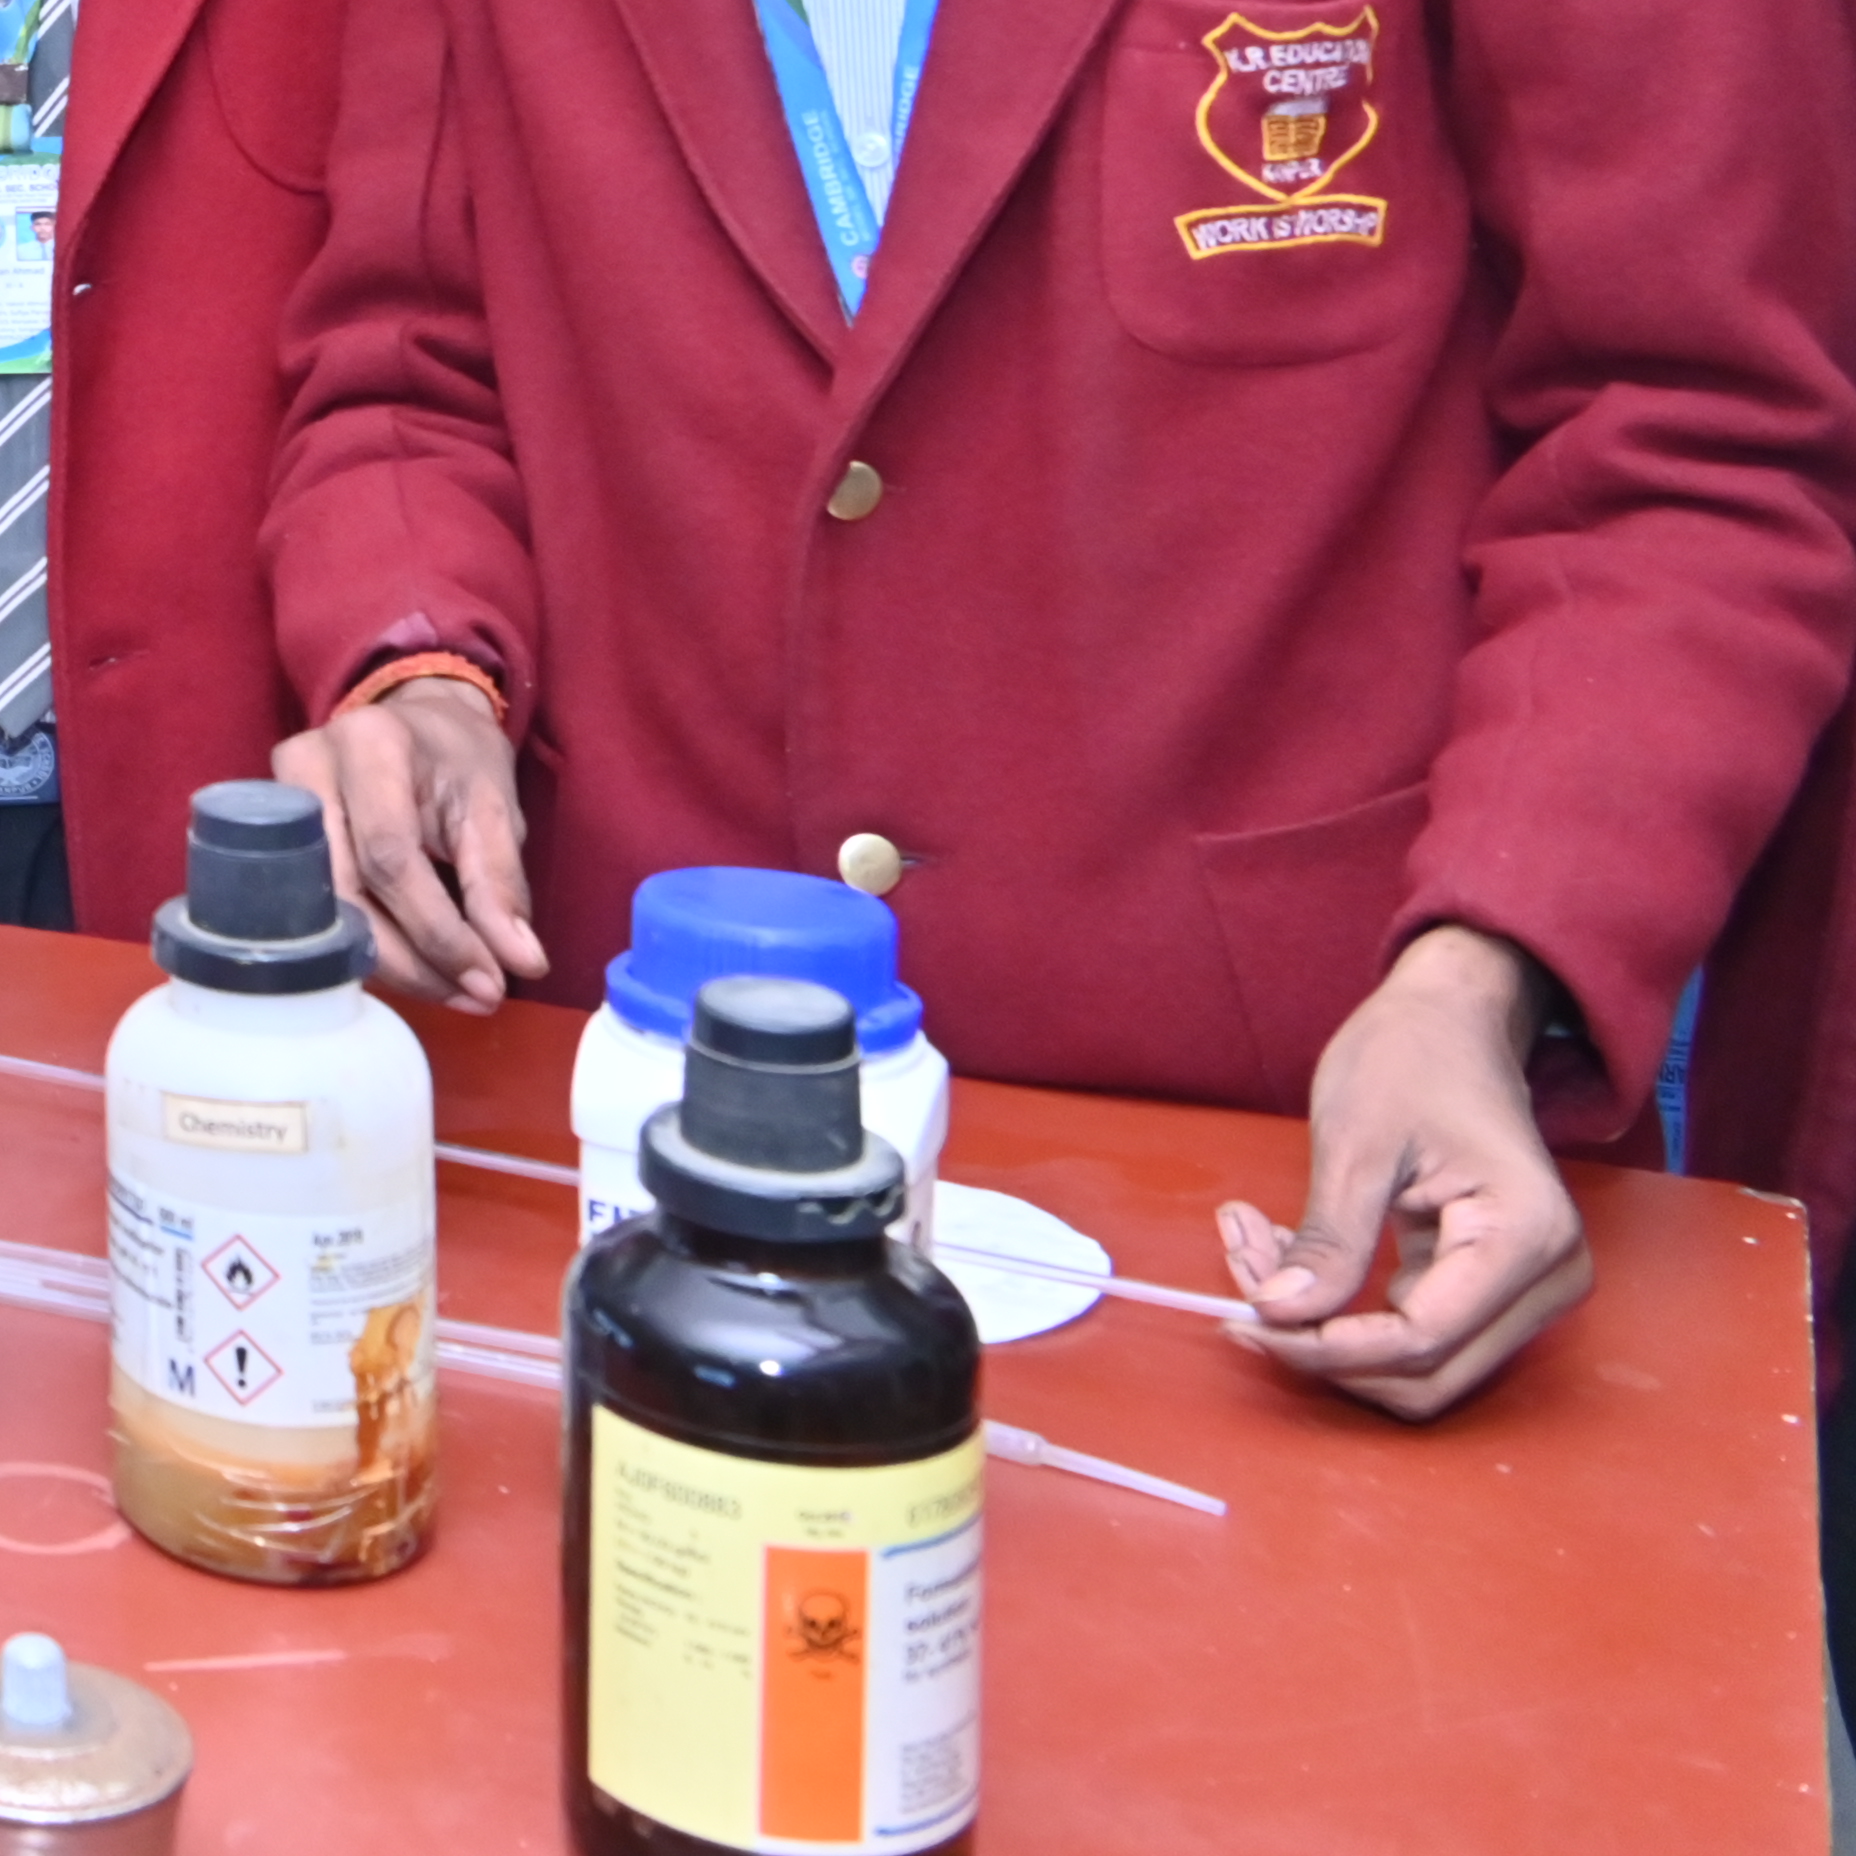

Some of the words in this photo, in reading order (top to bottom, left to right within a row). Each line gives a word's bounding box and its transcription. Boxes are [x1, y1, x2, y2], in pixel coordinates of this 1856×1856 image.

[1263, 65, 1349, 94] CENTRE
[801, 110, 859, 246] CAMBRIDGE
[1193, 217, 1269, 249] WORK
[177, 1111, 288, 1144] Chemistry
[168, 1357, 195, 1397] M
